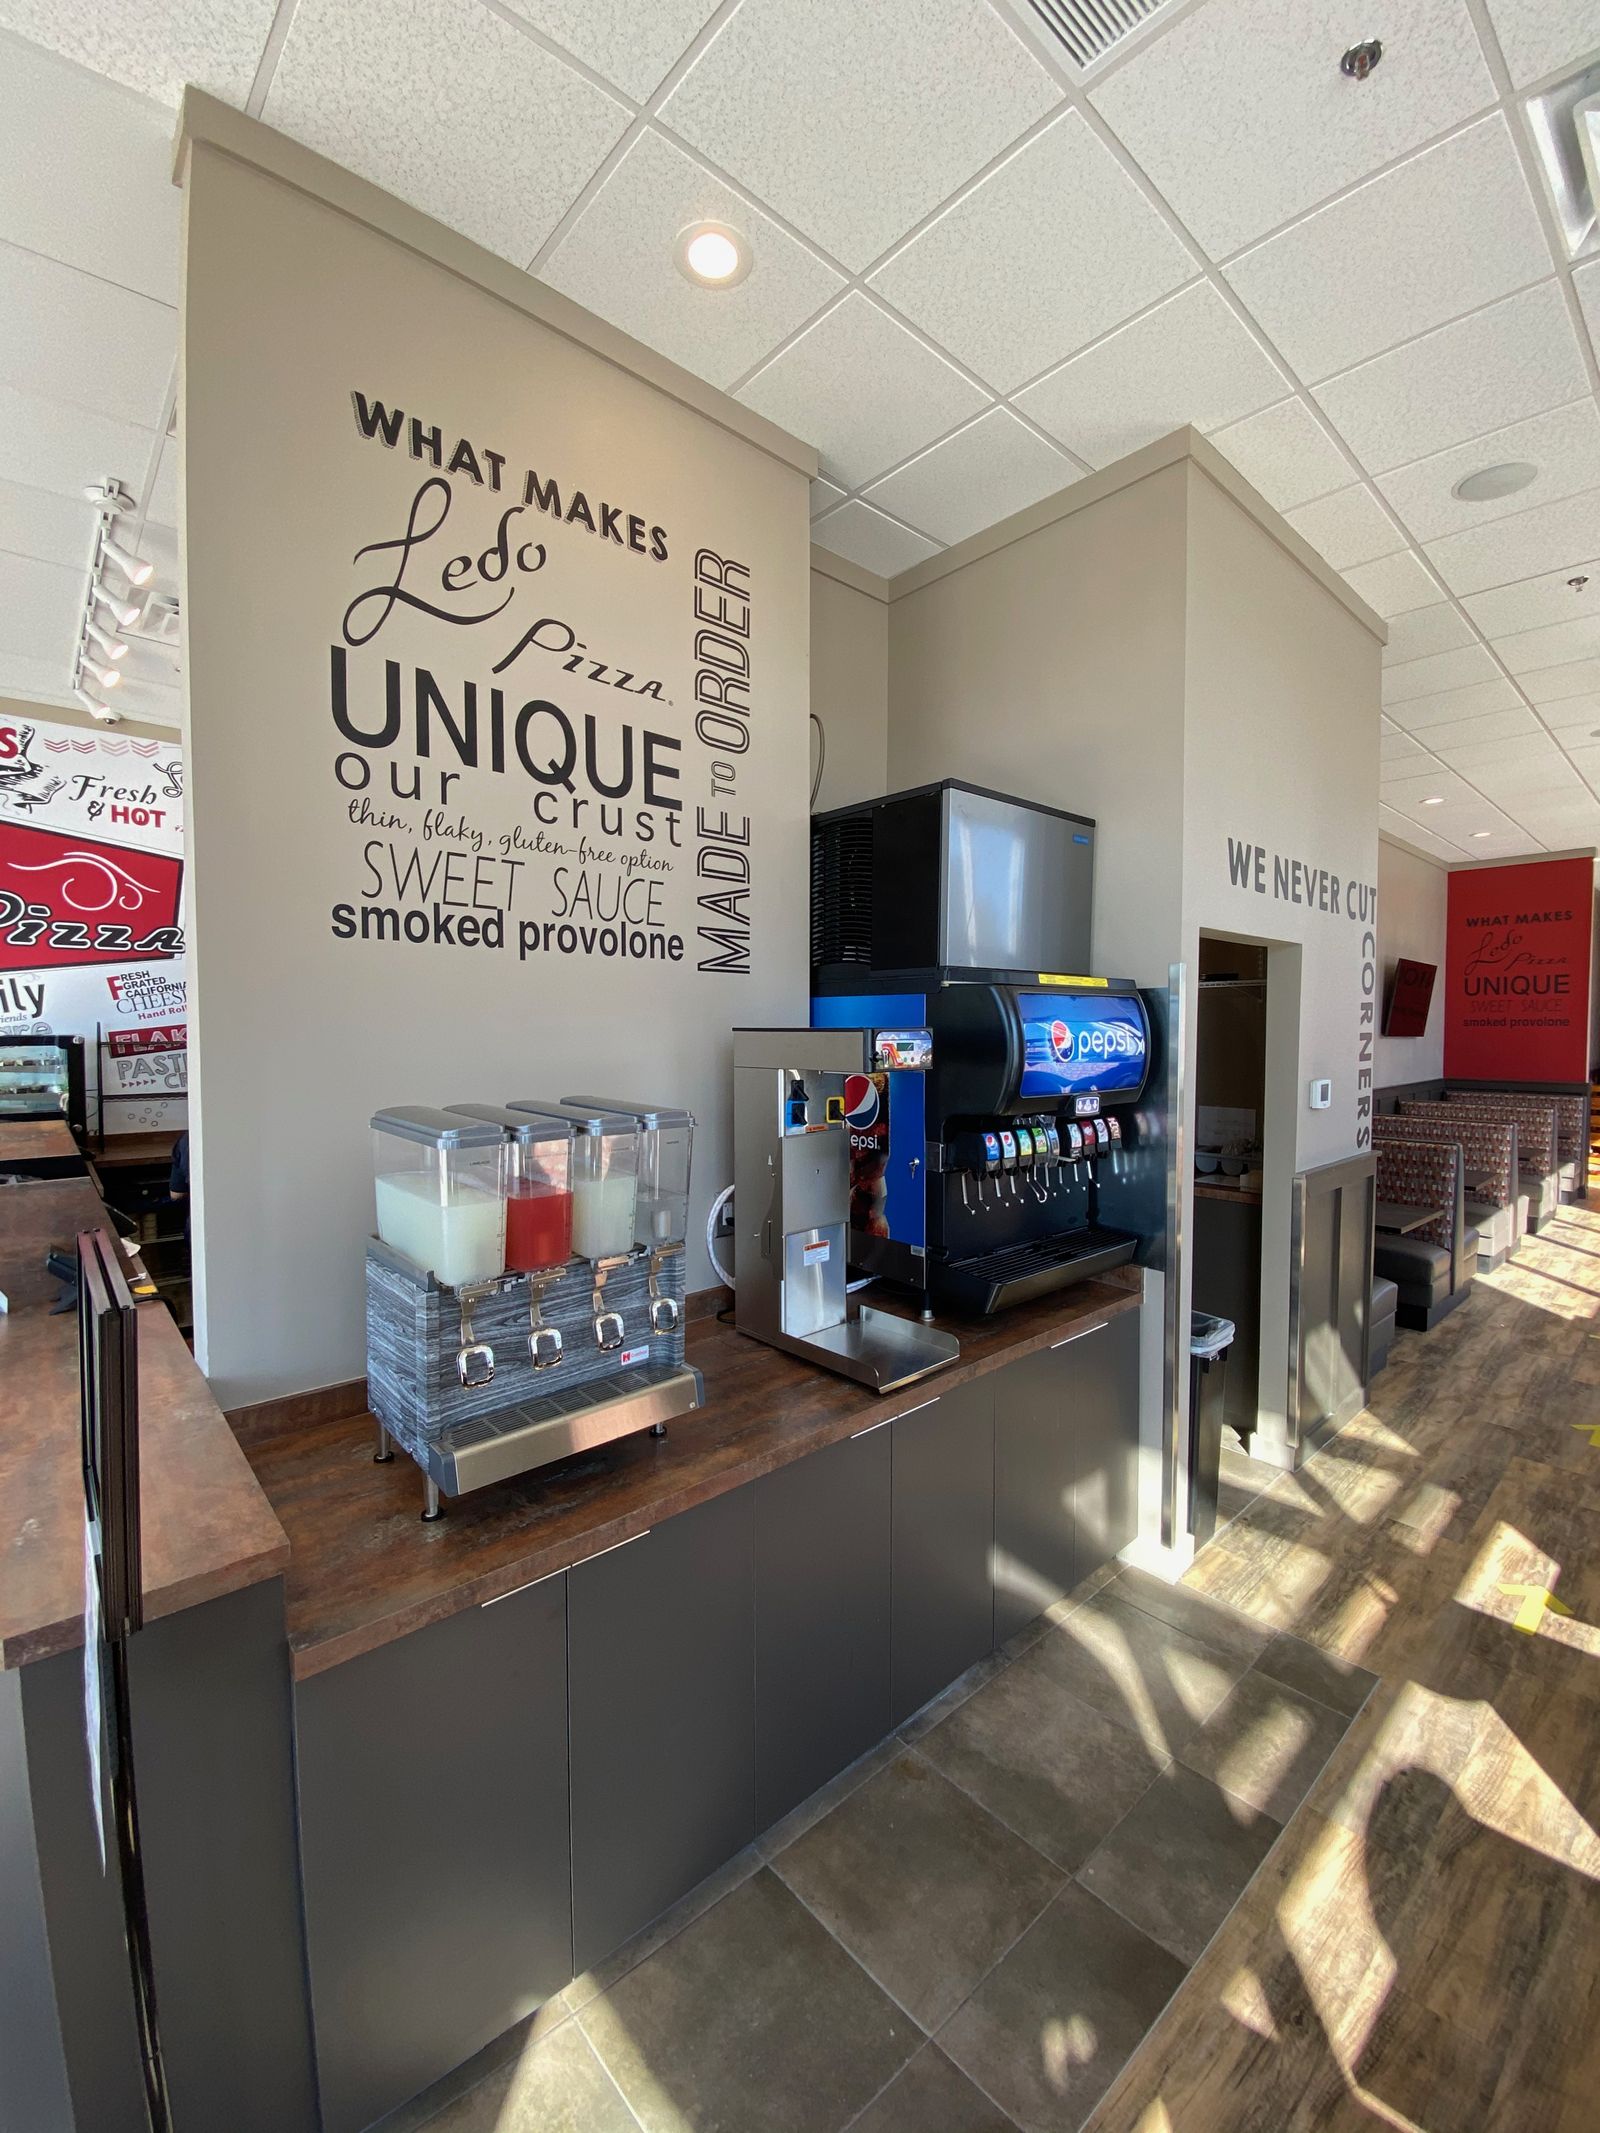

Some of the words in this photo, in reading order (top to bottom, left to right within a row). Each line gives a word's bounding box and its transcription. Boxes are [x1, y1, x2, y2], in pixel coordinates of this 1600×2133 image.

[351, 390, 506, 493] WHAT
[521, 470, 669, 562] MAKES
[342, 477, 547, 646] Ledo
[694, 548, 750, 754] ORDER
[331, 645, 683, 811] UNIQUE
[69, 775, 157, 804] Fresh
[335, 752, 460, 804] our
[533, 791, 682, 848] crust
[710, 760, 737, 798] TO
[87, 800, 105, 821] &
[111, 805, 166, 828] HOT
[348, 798, 413, 833] thin,
[423, 809, 493, 852] flaky,
[500, 826, 616, 865] gluten-free
[620, 849, 675, 877] option
[361, 840, 525, 912] SWEET
[552, 867, 666, 927] SAUCE
[697, 806, 750, 975] MADE
[1228, 837, 1266, 894] WE
[1274, 854, 1340, 914] NEVER
[1347, 881, 1377, 925] CUT
[331, 902, 505, 949] smoked
[518, 920, 685, 961] provolone
[1466, 915, 1509, 927] WHAT
[1515, 910, 1573, 924] MAKES
[107, 971, 150, 1000] FRESH
[123, 977, 166, 990] GRATED
[1463, 974, 1571, 996] UNIQUE
[138, 1009, 166, 1020] Hand
[1356, 931, 1375, 1149] CORNERS
[1463, 1017, 1506, 1027] smoked
[1510, 1016, 1569, 1029] provolone
[850, 1134, 879, 1150] epsi
